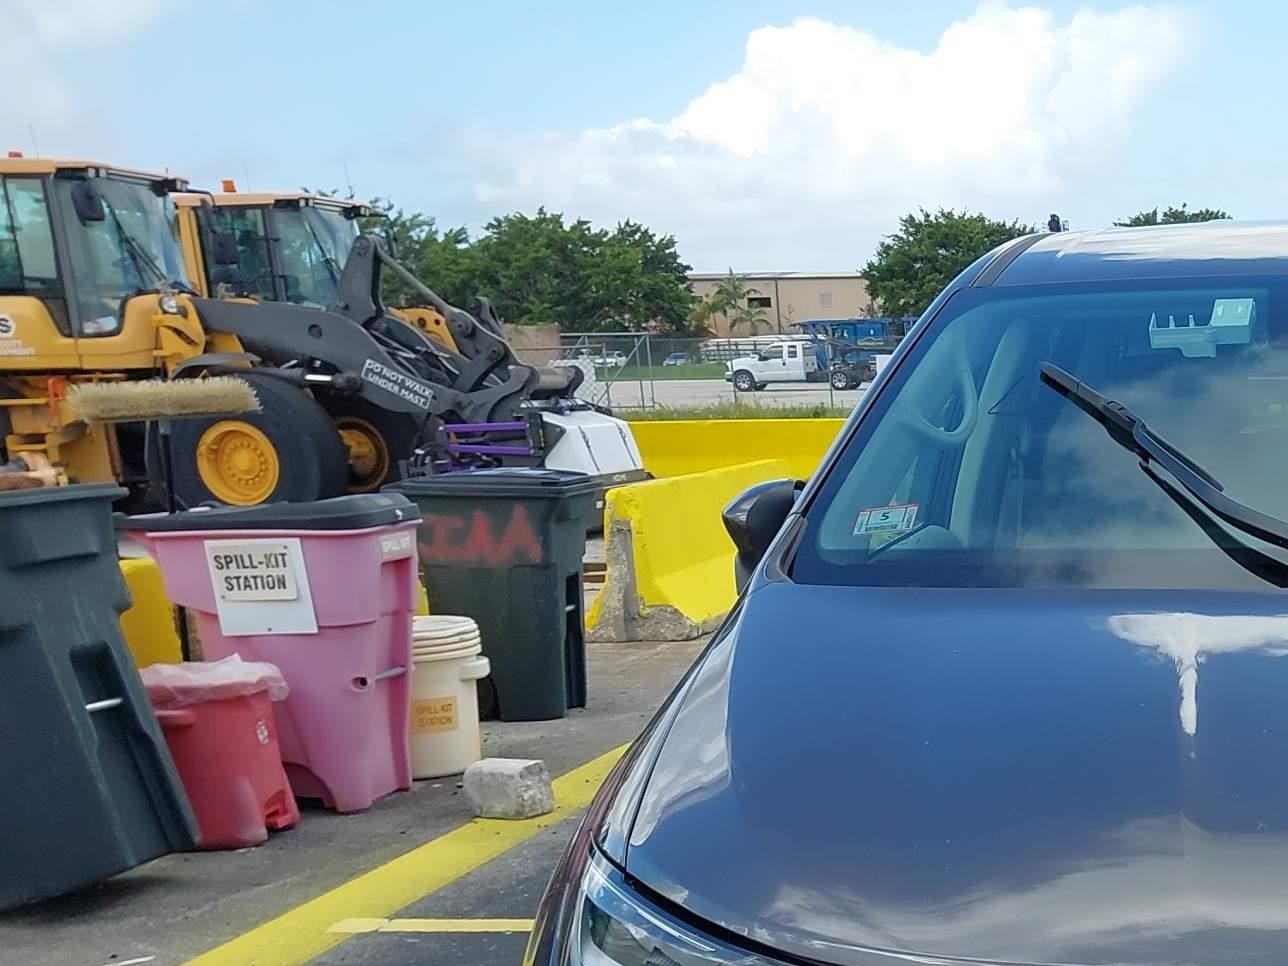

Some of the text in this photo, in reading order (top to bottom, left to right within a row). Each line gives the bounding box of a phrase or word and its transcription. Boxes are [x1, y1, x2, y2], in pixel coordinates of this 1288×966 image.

[366, 360, 434, 397] DO NOT WALK
[367, 372, 400, 393] UNDER
[880, 511, 890, 520] 5
[214, 552, 288, 570] SPILL-KIT
[224, 574, 287, 592] STATION
